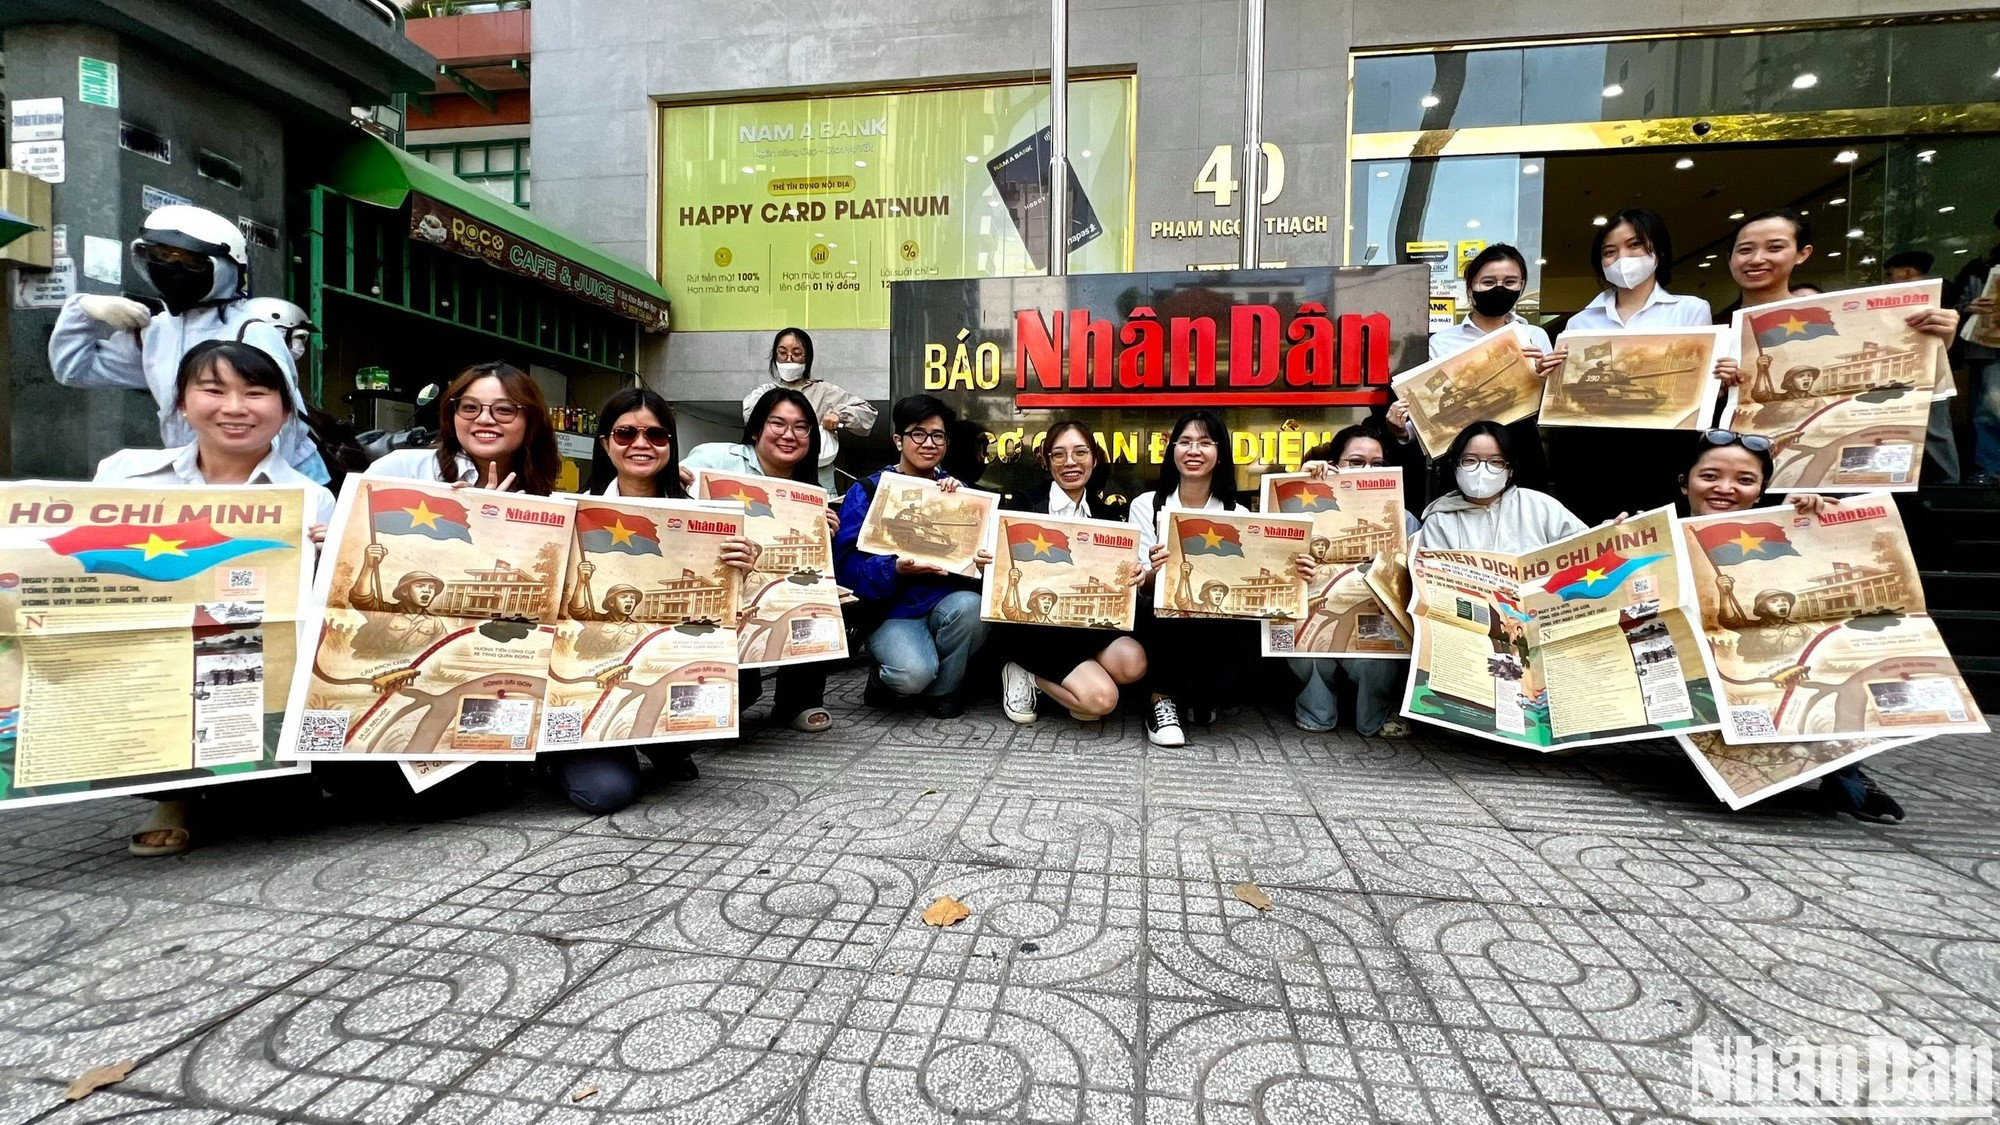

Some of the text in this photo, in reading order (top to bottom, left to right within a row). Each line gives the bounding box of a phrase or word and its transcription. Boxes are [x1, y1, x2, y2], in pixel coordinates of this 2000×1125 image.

[739, 117, 888, 142] NAM A BANK
[993, 159, 1009, 172] NAM
[1014, 145, 1033, 160] BANK
[1193, 142, 1285, 207] 40
[773, 180, 850, 191] THẺ TÍN DỤNG NỘI ĐỊA
[679, 196, 949, 226] HAPPY CARD PLATINUM
[1151, 215, 1328, 241] PHẠM NGỌ THẠCH
[1067, 228, 1089, 246] napas
[510, 245, 615, 304] CAFE & JUICE
[687, 274, 700, 283] Rút
[718, 273, 735, 283] mặt
[738, 273, 760, 281] 100%
[782, 271, 800, 281] Hạn
[801, 271, 820, 280] mức
[822, 271, 833, 279] tín
[894, 267, 912, 277] suất
[687, 284, 760, 294] Hạn mức tín dụng
[779, 279, 860, 292] lên đến 01 tỷ đồng
[1429, 303, 1448, 311] ANK
[1866, 294, 1930, 308] Nhân Dân
[924, 302, 1390, 390] BÁO Nhân Dân
[1585, 375, 1601, 383] 390
[1356, 478, 1396, 489] Nhân Dân
[791, 490, 810, 502] Nhân
[810, 495, 823, 505] Dân
[9, 496, 282, 524] HỒ CHÍ MINH
[505, 507, 565, 525] Nhân Dân
[1817, 506, 1886, 524] Nhân Dân
[687, 519, 715, 532] Nhân
[716, 522, 736, 534] Dân
[1264, 526, 1287, 536] Nhân
[1287, 527, 1305, 538] Dân
[1093, 533, 1116, 545] Nhân
[1116, 535, 1133, 547] Dân
[1523, 557, 1550, 580] HỒ
[1556, 541, 1590, 570] CHÍ
[1596, 527, 1658, 559] MINH
[1480, 557, 1519, 581] DỊCH
[25, 615, 45, 630] N
